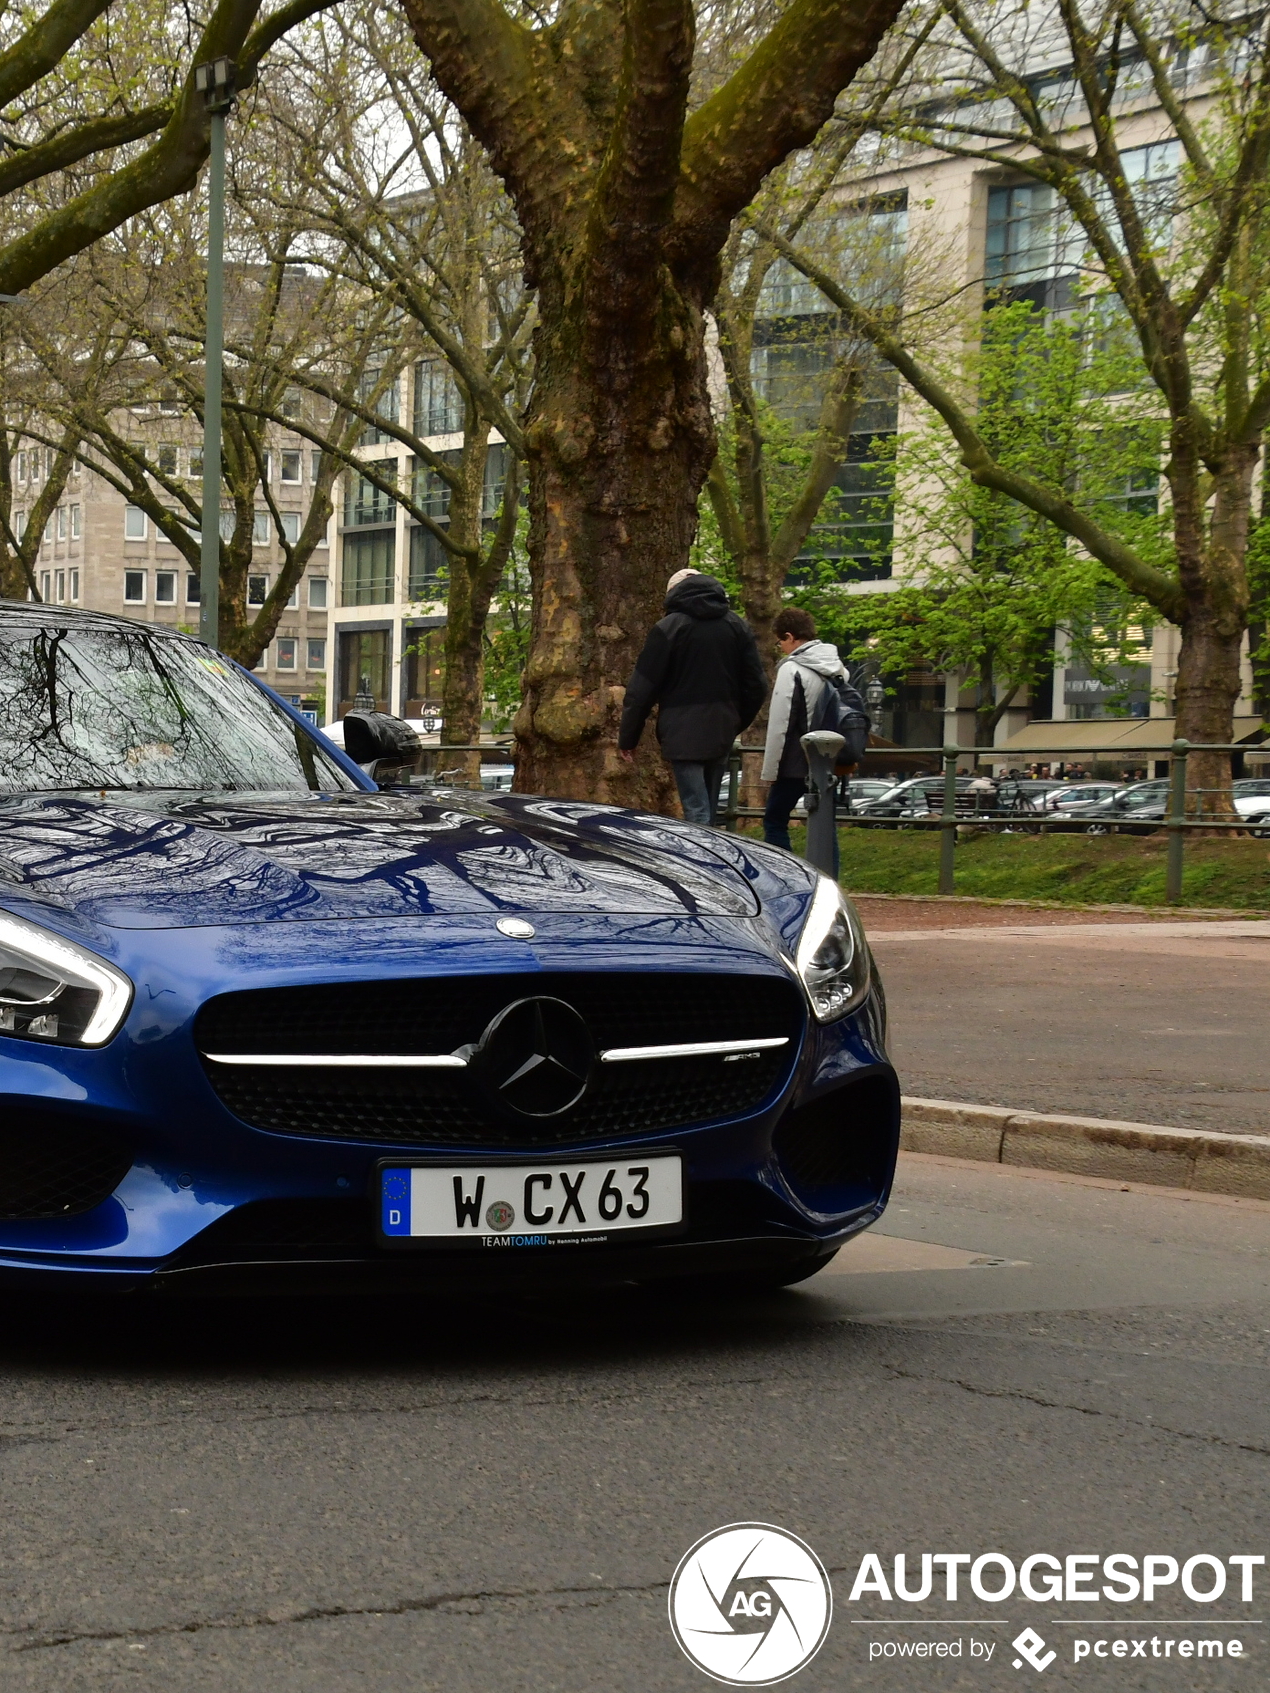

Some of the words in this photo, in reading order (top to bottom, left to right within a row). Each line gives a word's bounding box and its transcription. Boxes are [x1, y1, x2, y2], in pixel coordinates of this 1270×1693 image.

[452, 1175, 486, 1228] W
[389, 1209, 401, 1225] D
[481, 1235, 548, 1247] TEAMTOMRU
